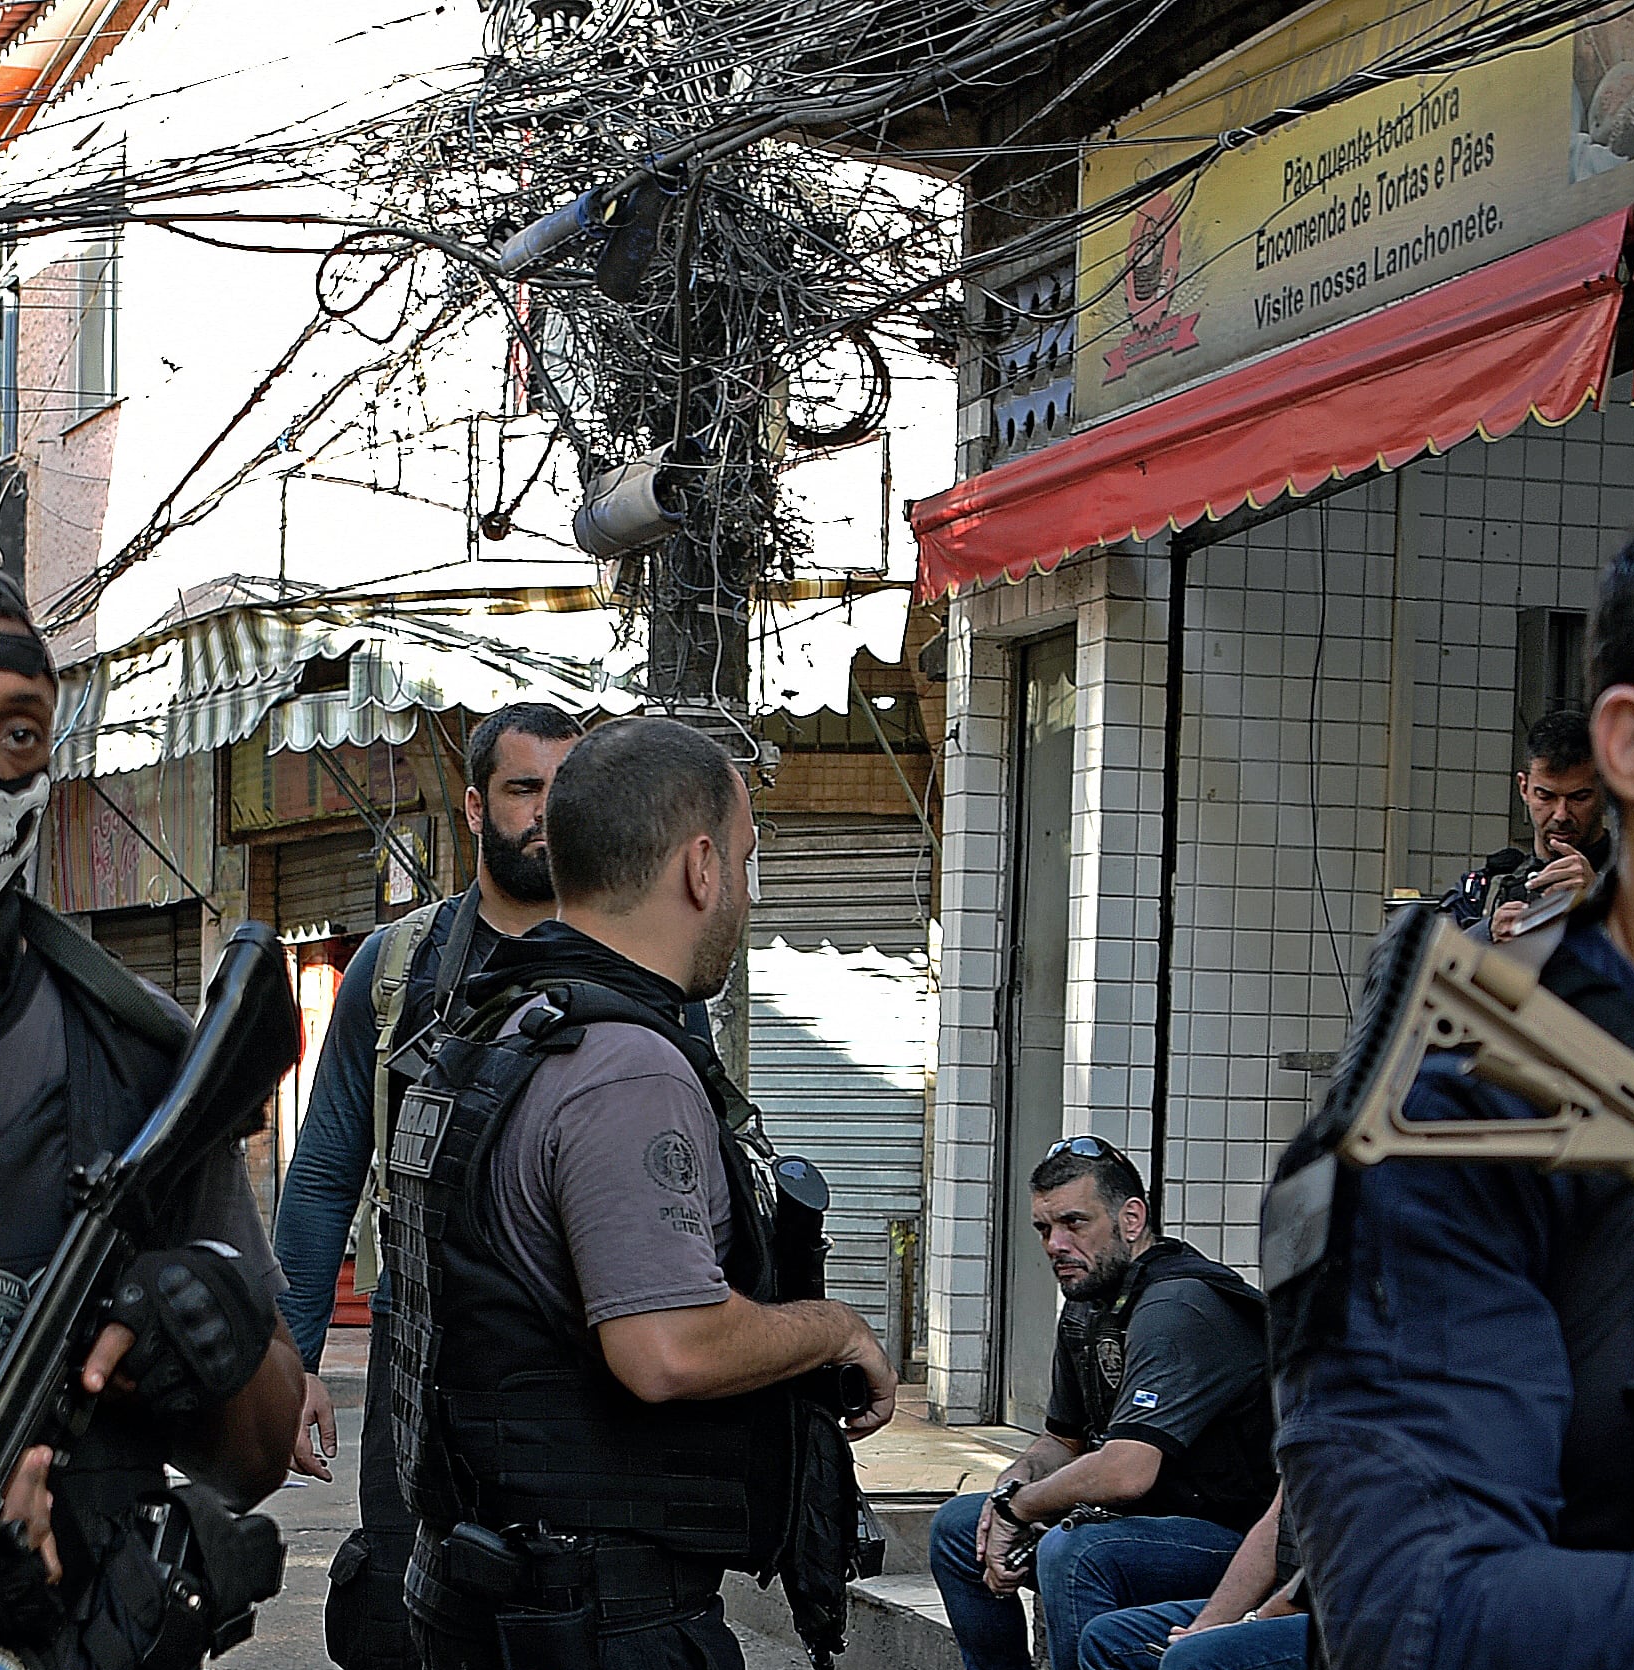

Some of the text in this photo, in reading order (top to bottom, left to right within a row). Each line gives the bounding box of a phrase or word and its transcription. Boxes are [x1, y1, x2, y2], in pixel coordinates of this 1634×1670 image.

[1256, 131, 1495, 271] Encomenda de Tortas e Pães
[1283, 87, 1460, 202] Pão quente toda hora
[1254, 203, 1503, 330] Visite nossa Lanchonete.
